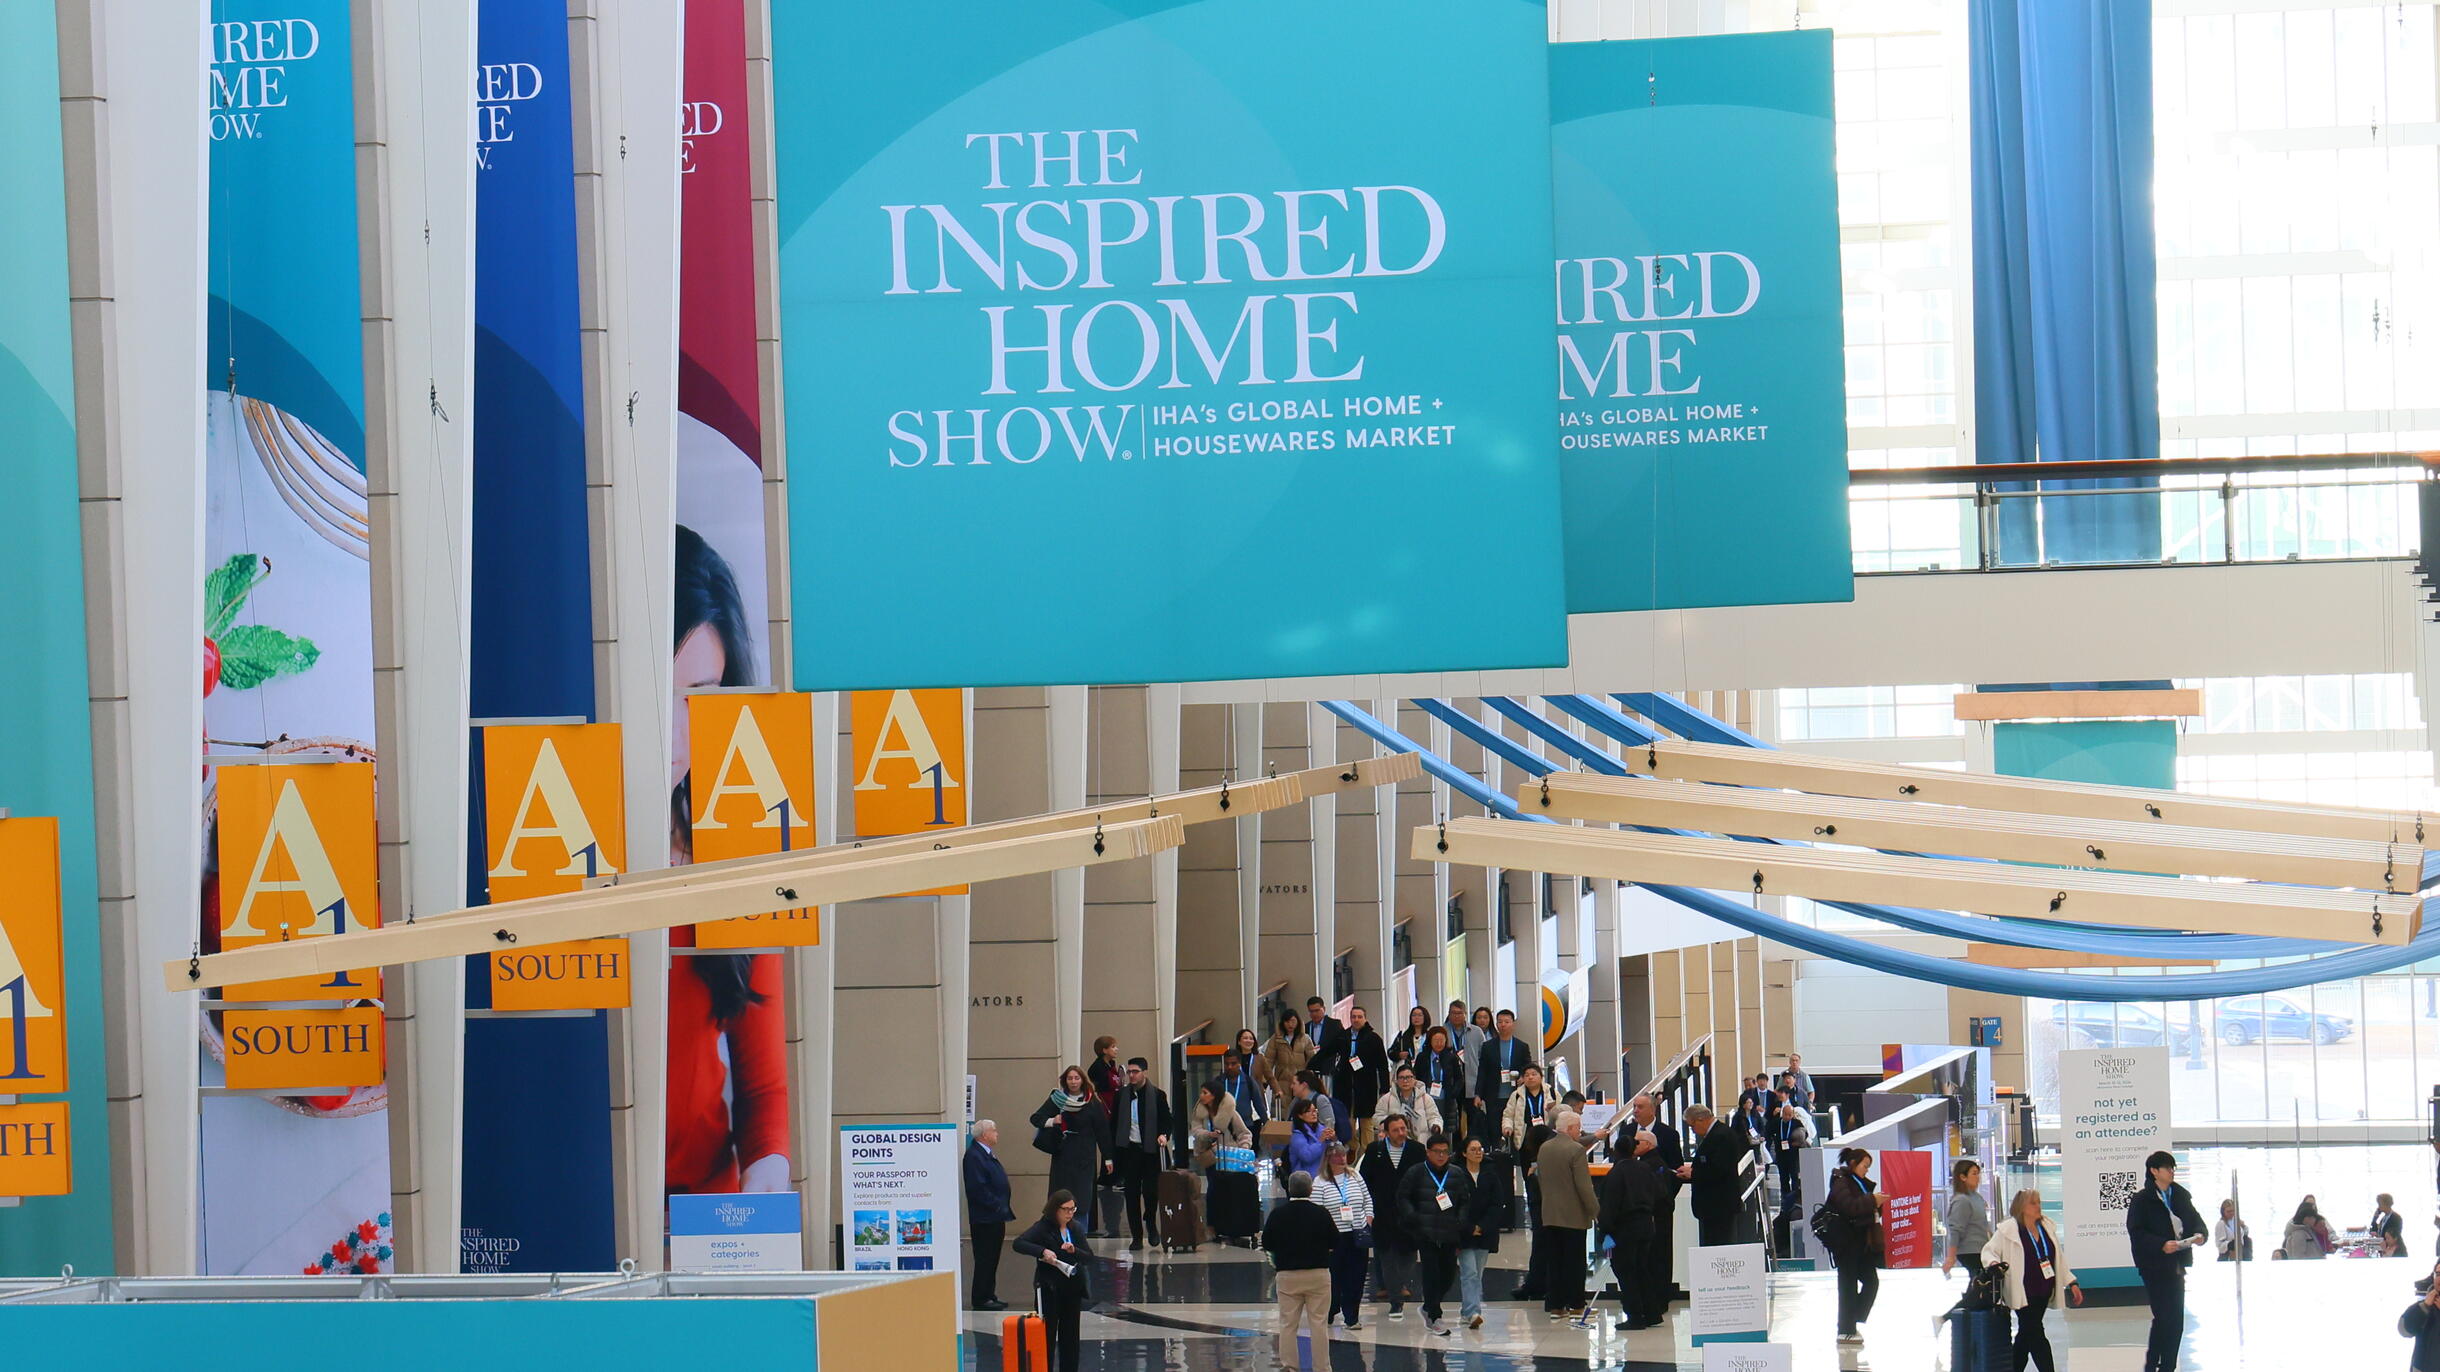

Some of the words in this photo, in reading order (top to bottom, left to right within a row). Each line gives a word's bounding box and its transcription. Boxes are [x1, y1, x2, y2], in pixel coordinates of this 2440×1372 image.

[477, 63, 543, 102] ED
[966, 128, 1143, 189] THE
[880, 185, 1447, 295] INSPIRED
[980, 291, 1365, 395] HOME
[1557, 328, 1701, 400] ME
[1227, 398, 1335, 423] GLOBAL
[1343, 394, 1422, 418] HOME
[1432, 397, 1444, 410] +
[1601, 406, 1679, 425] GLOBAL
[1686, 403, 1744, 421] HOME
[1153, 427, 1337, 457] HOUSEWARES
[1346, 425, 1457, 449] MARKET
[1561, 429, 1681, 450] OUSEWARES
[1688, 425, 1769, 444] MARKET
[498, 953, 621, 981] SOUTH
[231, 1023, 370, 1056] SOUTH
[1993, 1027, 2002, 1042] 4
[2094, 1058, 2136, 1067] INSPIRED
[2101, 1066, 2129, 1075] HOME
[2094, 1098, 2114, 1108] not
[2118, 1097, 2137, 1109] yet
[2076, 1112, 2139, 1126] registered
[2143, 1112, 2157, 1121] as
[852, 1133, 897, 1144] GLOBAL
[899, 1133, 941, 1143] DESIGN
[2076, 1130, 2092, 1139] an
[2095, 1125, 2158, 1138] attendee?
[852, 1148, 893, 1158] POINTS
[853, 1171, 875, 1179] YOUR
[917, 1170, 928, 1178] TO
[853, 1181, 882, 1189] WHAT'S
[715, 1207, 755, 1215] INSPIRED
[722, 1214, 749, 1222] HOME
[460, 1228, 483, 1237] THE
[711, 1241, 738, 1249] expos
[463, 1251, 510, 1265] HOME
[711, 1250, 760, 1260] categories
[1711, 1260, 1745, 1269] INSPIRED
[1717, 1267, 1740, 1275] HOME
[1728, 1360, 1768, 1368] INSPIRED
